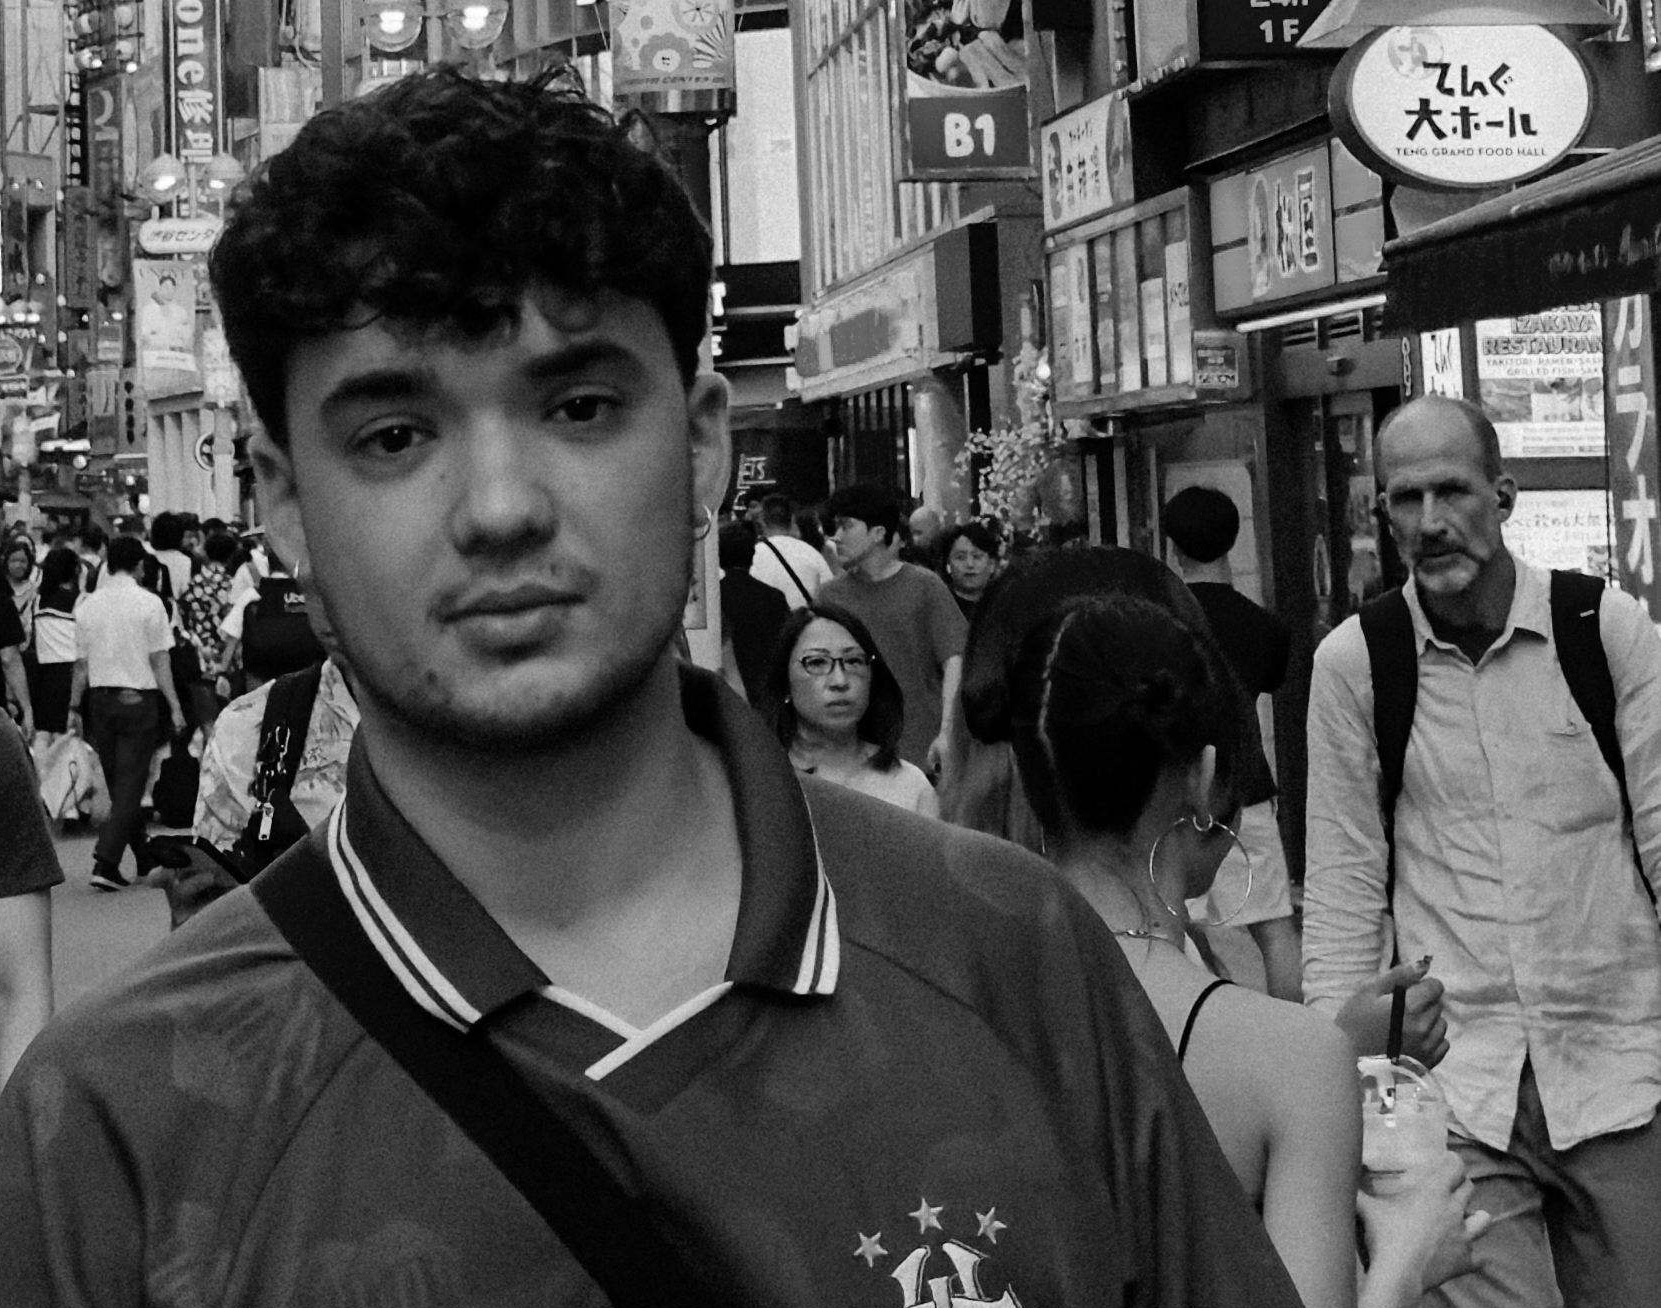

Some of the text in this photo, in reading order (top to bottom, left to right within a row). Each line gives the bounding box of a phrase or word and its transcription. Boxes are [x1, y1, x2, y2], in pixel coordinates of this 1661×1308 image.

[1259, 18, 1300, 44] 1F
[1422, 62, 1513, 97] てんぐ
[1404, 98, 1538, 141] 大ホール
[944, 113, 995, 157] B1
[1432, 147, 1474, 156] GRAND
[1478, 147, 1513, 156] FOOD
[1518, 147, 1546, 156] HALL
[1511, 314, 1598, 334] IZAKAYA
[1483, 335, 1603, 355] RESTAURAN
[1611, 294, 1658, 585] カラオ
